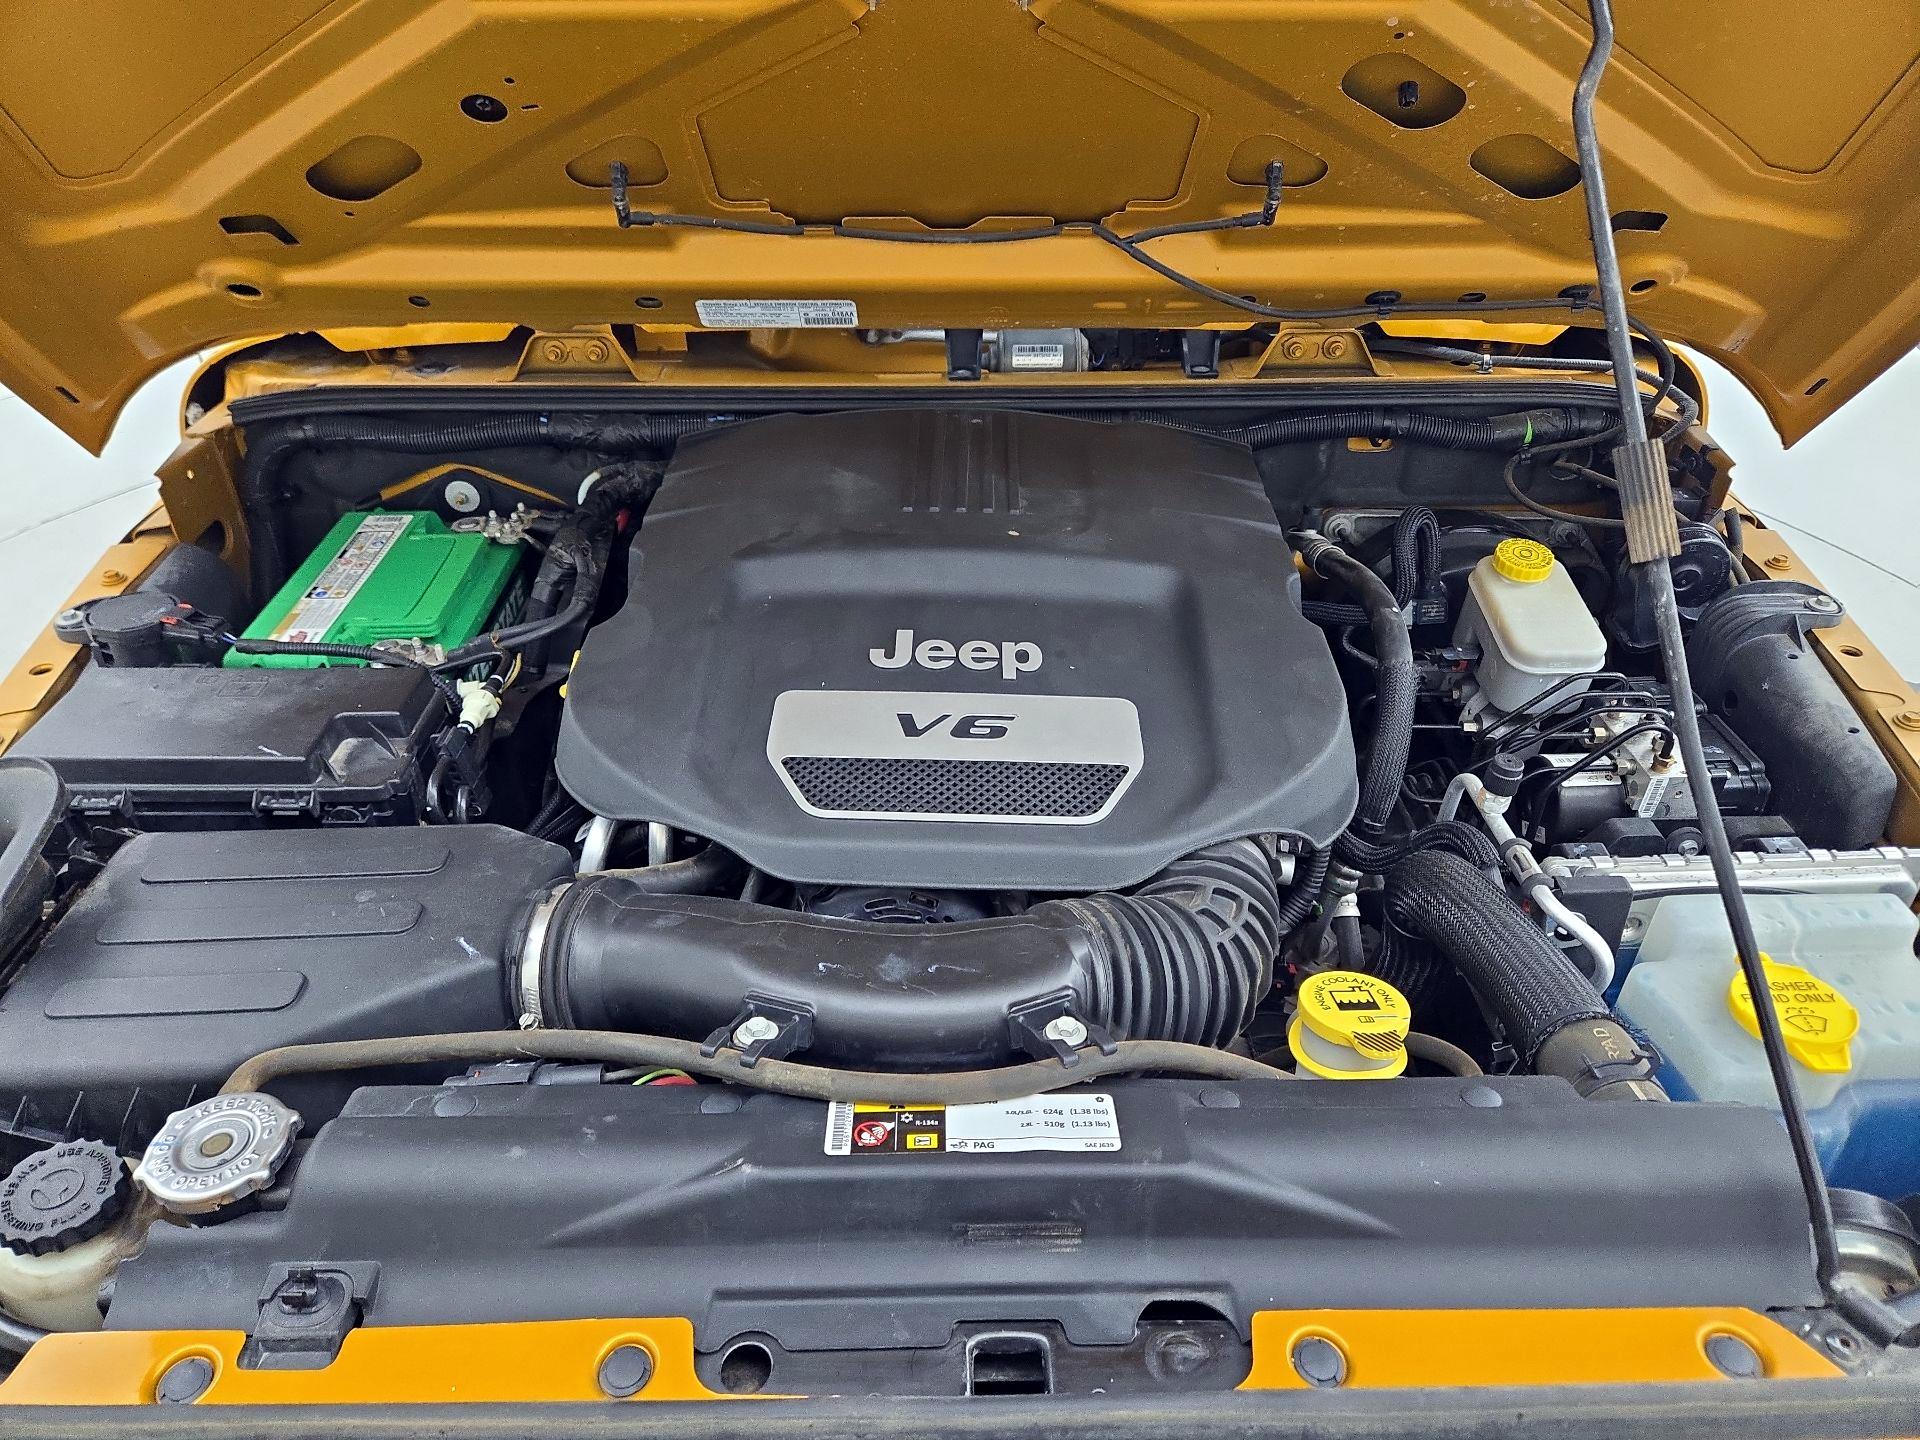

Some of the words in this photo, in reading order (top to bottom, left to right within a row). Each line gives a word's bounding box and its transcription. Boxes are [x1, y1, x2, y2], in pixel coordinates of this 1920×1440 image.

[869, 629, 1043, 680] Jeep
[896, 712, 1018, 740] V6
[1322, 976, 1376, 988] COOLANT
[1314, 985, 1331, 1010] ENGINE
[1376, 988, 1396, 1008] ONLY
[1740, 993, 1790, 1003] FID
[1794, 993, 1836, 1003] ONLY
[196, 1098, 247, 1117] KEEP
[1043, 1108, 1064, 1116] 624g
[1069, 1108, 1091, 1116] (1.38
[1093, 1108, 1109, 1116] lbs)
[1044, 1121, 1065, 1129] 510g
[1071, 1121, 1093, 1129] (1.13
[1094, 1121, 1111, 1129] lbs)
[57, 1147, 84, 1158] USE
[973, 1141, 995, 1149] PAG
[171, 1171, 224, 1190] OPEN
[227, 1149, 262, 1178] HOT
